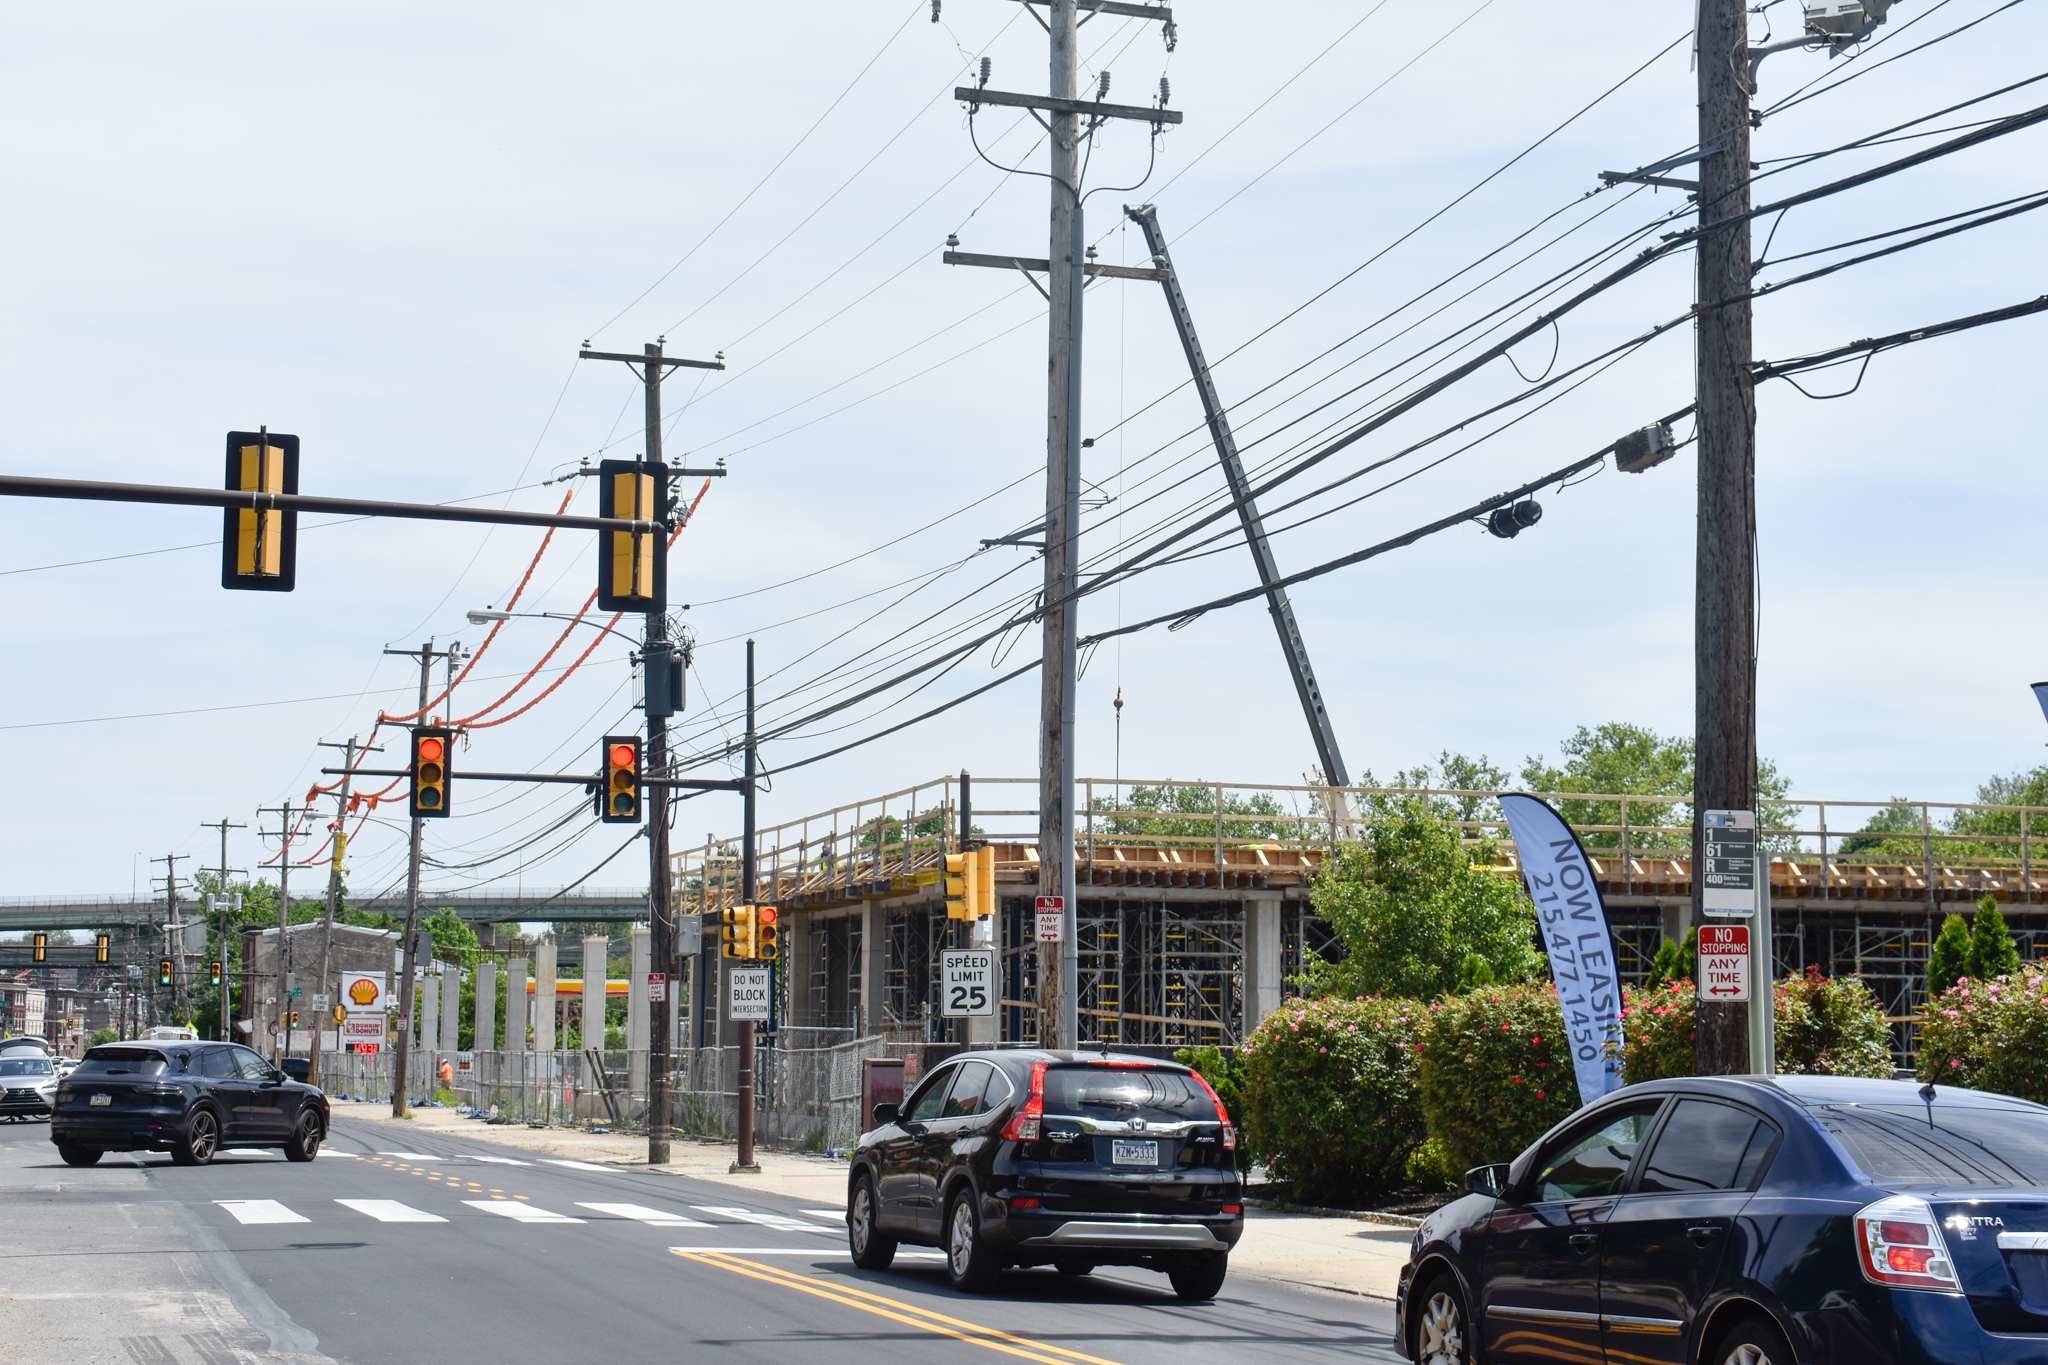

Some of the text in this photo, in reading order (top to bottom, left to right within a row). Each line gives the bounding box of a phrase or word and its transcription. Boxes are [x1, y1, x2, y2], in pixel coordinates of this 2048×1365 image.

[1706, 828, 1714, 842] 1
[1706, 843, 1721, 857] 61
[1706, 859, 1716, 872] R
[1549, 838, 1597, 922] NOW
[1706, 874, 1723, 884] 400
[1044, 898, 1055, 907] NO
[1037, 906, 1063, 914] STOPPING
[1715, 928, 1733, 942] NO
[1702, 943, 1747, 953] STOPPING
[947, 957, 988, 968] SPEED
[1532, 872, 1597, 1061] 215.477.1450
[1708, 958, 1740, 969] ANY
[734, 975, 765, 985] DO NOT
[951, 971, 984, 982] LIMIT
[1708, 972, 1741, 983] TIME
[734, 989, 766, 1001] BLOCK
[950, 986, 987, 1010] 25
[1577, 932, 1621, 1073] LEASIN
[732, 1005, 768, 1013] INTERSECTION
[1945, 1216, 2004, 1227] SNTRA
